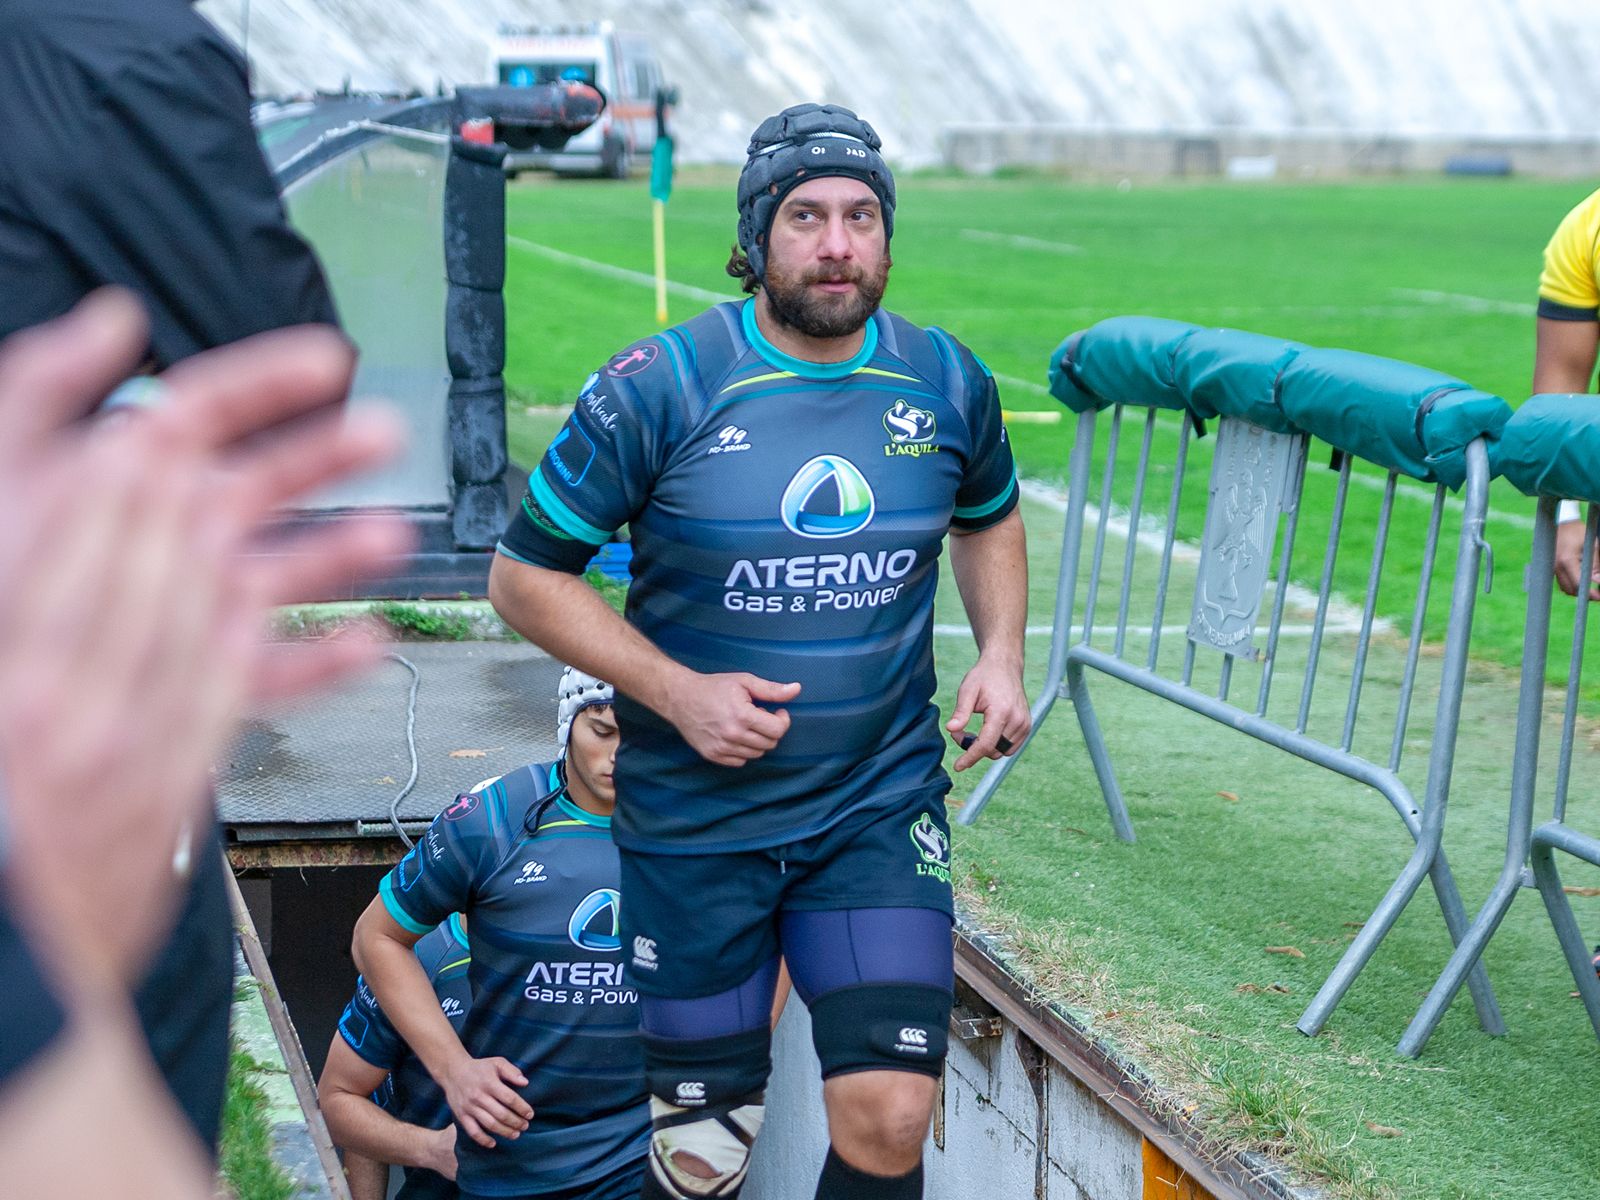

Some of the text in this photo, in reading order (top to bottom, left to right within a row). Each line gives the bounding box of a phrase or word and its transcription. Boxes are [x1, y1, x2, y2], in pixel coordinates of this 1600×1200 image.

[724, 549, 917, 588] ATERNO
[724, 583, 904, 612] Gas & Power
[916, 863, 950, 882] L'AQU
[525, 961, 624, 986] ATER
[525, 986, 638, 1004] Gas & Pow
